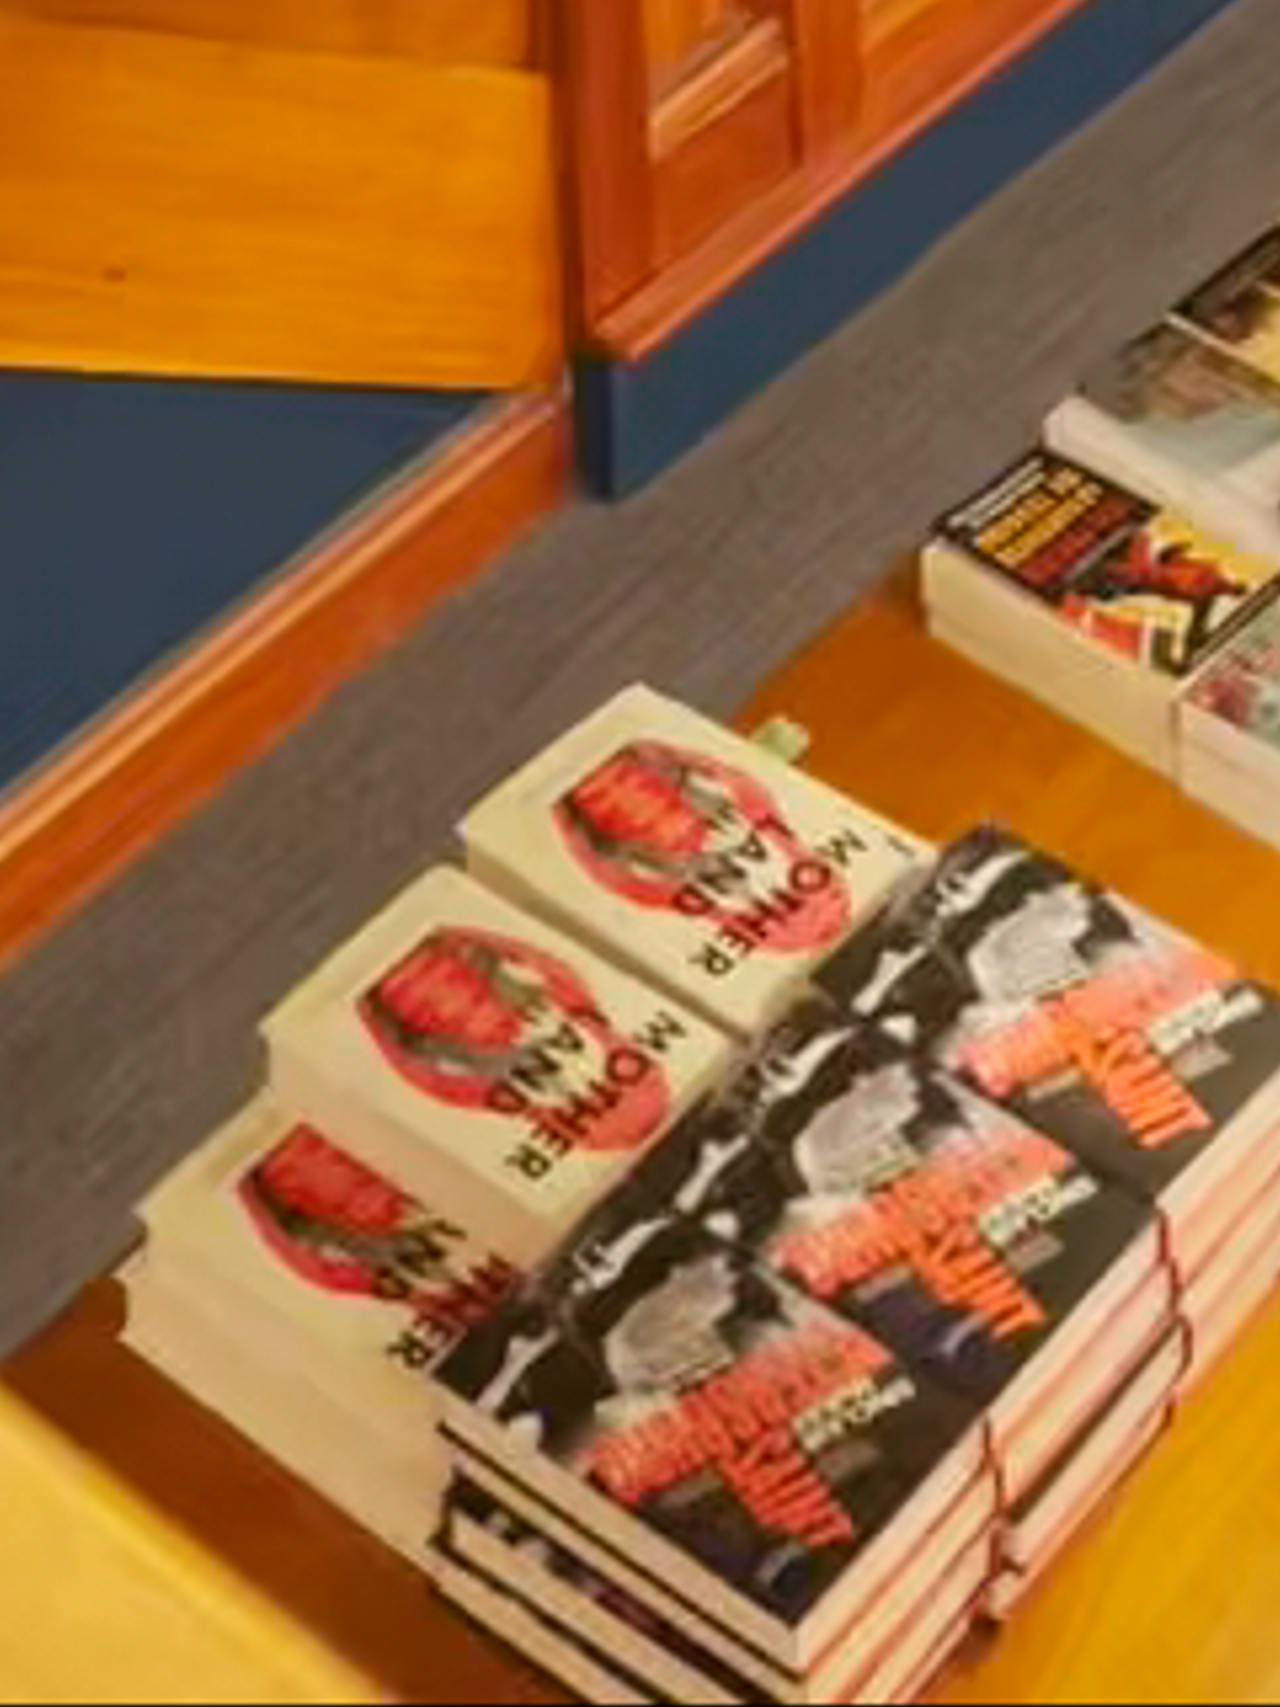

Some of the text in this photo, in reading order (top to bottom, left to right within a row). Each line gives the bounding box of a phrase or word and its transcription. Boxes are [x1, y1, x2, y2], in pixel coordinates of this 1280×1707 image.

[672, 814, 794, 917] LAND
[686, 826, 869, 976] MOTHER
[484, 1003, 612, 1116] LAND
[503, 1010, 688, 1180] MOTHER
